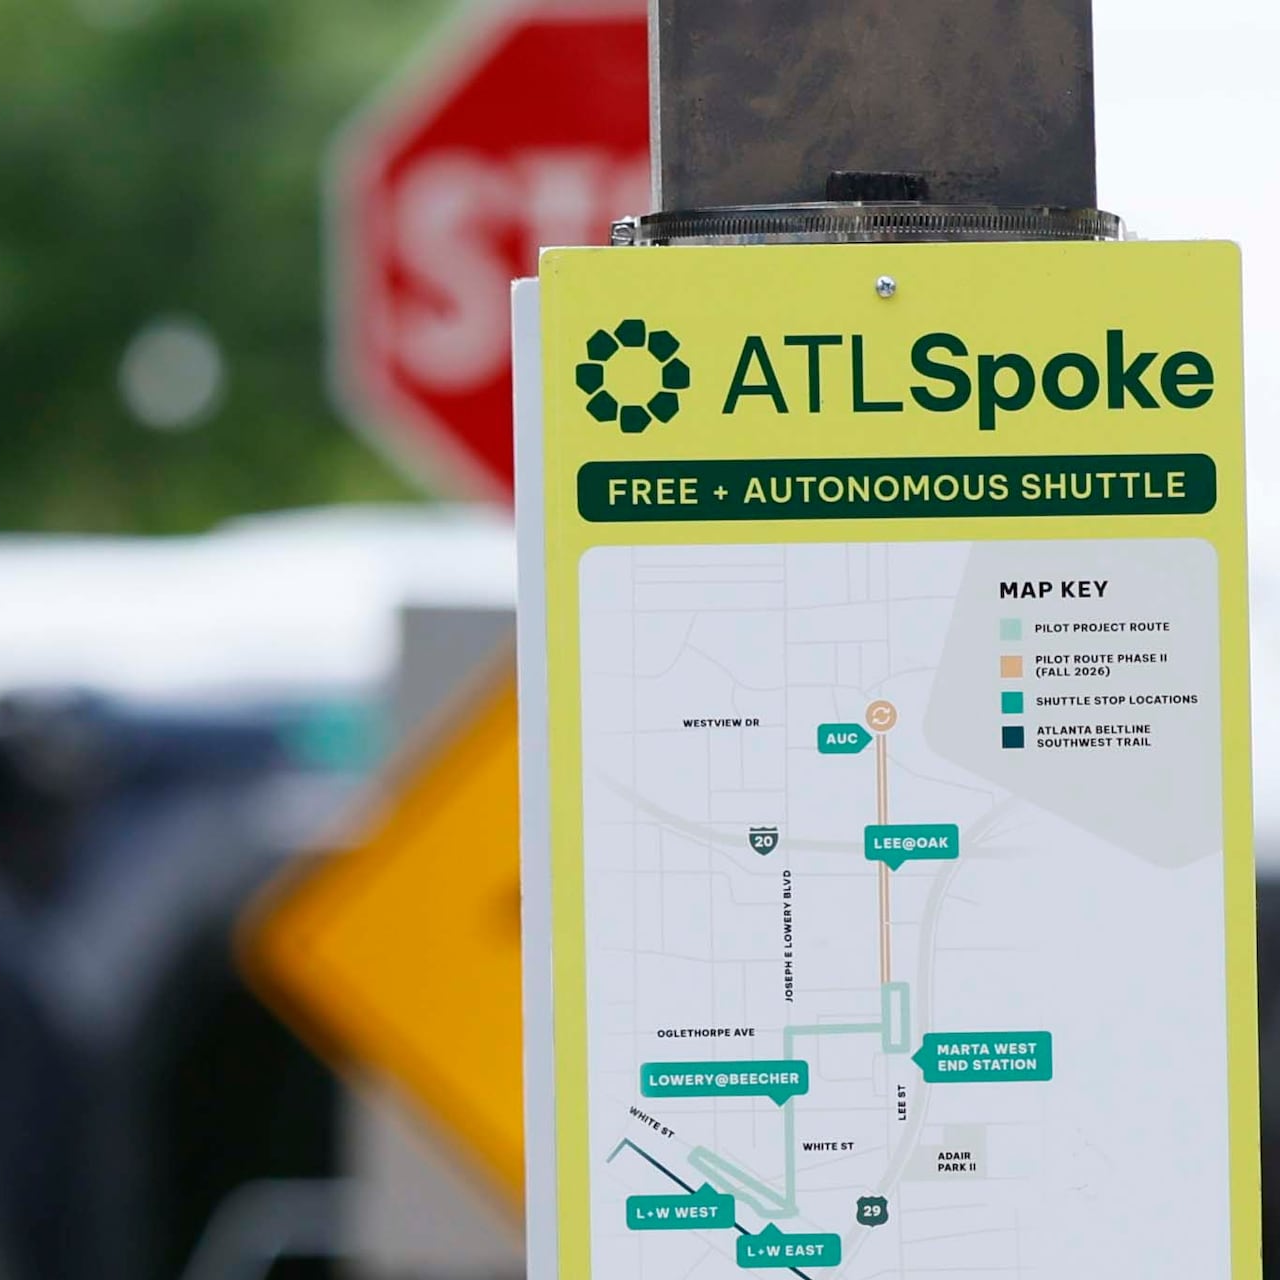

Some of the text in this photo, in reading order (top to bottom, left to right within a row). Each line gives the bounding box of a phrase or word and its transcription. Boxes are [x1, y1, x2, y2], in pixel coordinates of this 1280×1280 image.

[393, 150, 651, 382] ST
[722, 330, 1214, 430] ATLSpoke
[608, 478, 698, 506] FREE
[743, 473, 1009, 504] AUTONOMOUS
[1021, 471, 1186, 500] SHUTTLE
[999, 580, 1108, 599] MAP KEY
[1034, 622, 1170, 633] PILOT PROJECT ROUTE
[1034, 653, 1167, 665] PILOT ROUTE PHASE II
[1035, 665, 1111, 679] (FALL 2026)
[1036, 694, 1198, 707] SHUTTLE STOP LOCATIONS
[683, 718, 760, 728] WESTVIEW DR
[1037, 724, 1151, 735] ATLANTA BELTLINE
[826, 732, 858, 745] AUC
[1036, 737, 1151, 748] SOUTHWEST TRAIL
[753, 835, 773, 849] 20
[873, 836, 948, 851] LEE@OAK
[782, 869, 792, 899] BLVD
[784, 903, 792, 948] LOWERY
[785, 961, 793, 1002] JOSEPH
[656, 1027, 755, 1038] OGLETHORPE AVE
[937, 1042, 1037, 1056] MARTA WEST
[937, 1058, 1037, 1072] END STATION
[649, 1072, 800, 1088] LOWERY@BEECHER
[897, 1084, 907, 1121] LEE ST
[629, 1105, 675, 1139] WHITE ST
[802, 1141, 855, 1151] WHITE ST
[937, 1151, 971, 1161] ADAIR
[937, 1162, 977, 1172] PARK II
[674, 1206, 718, 1219] WEST
[863, 1204, 882, 1217] 29
[785, 1244, 825, 1257] EAST
